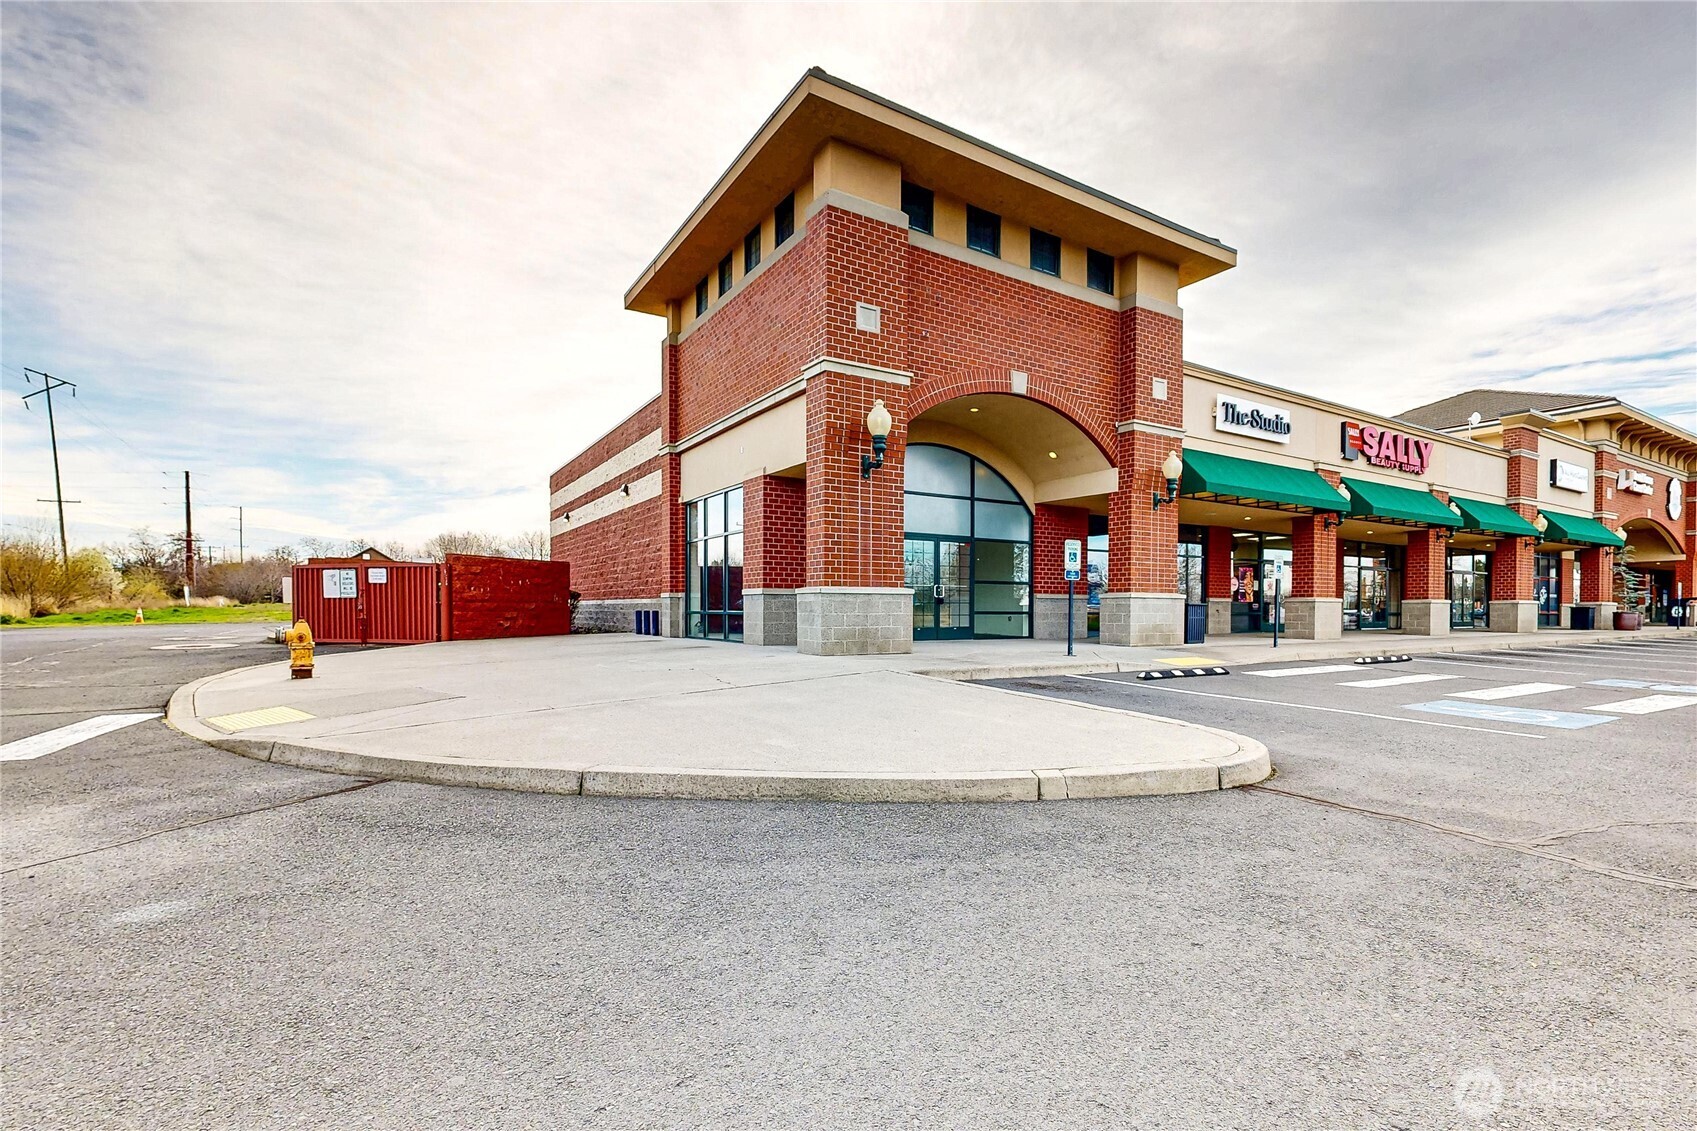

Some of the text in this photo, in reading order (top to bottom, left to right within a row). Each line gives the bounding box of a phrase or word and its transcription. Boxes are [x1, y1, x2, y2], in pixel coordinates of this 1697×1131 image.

[1222, 402, 1291, 434] The Studio
[1362, 426, 1434, 467] SALLY
[1371, 457, 1426, 475] BEAUTY SUPPLY
